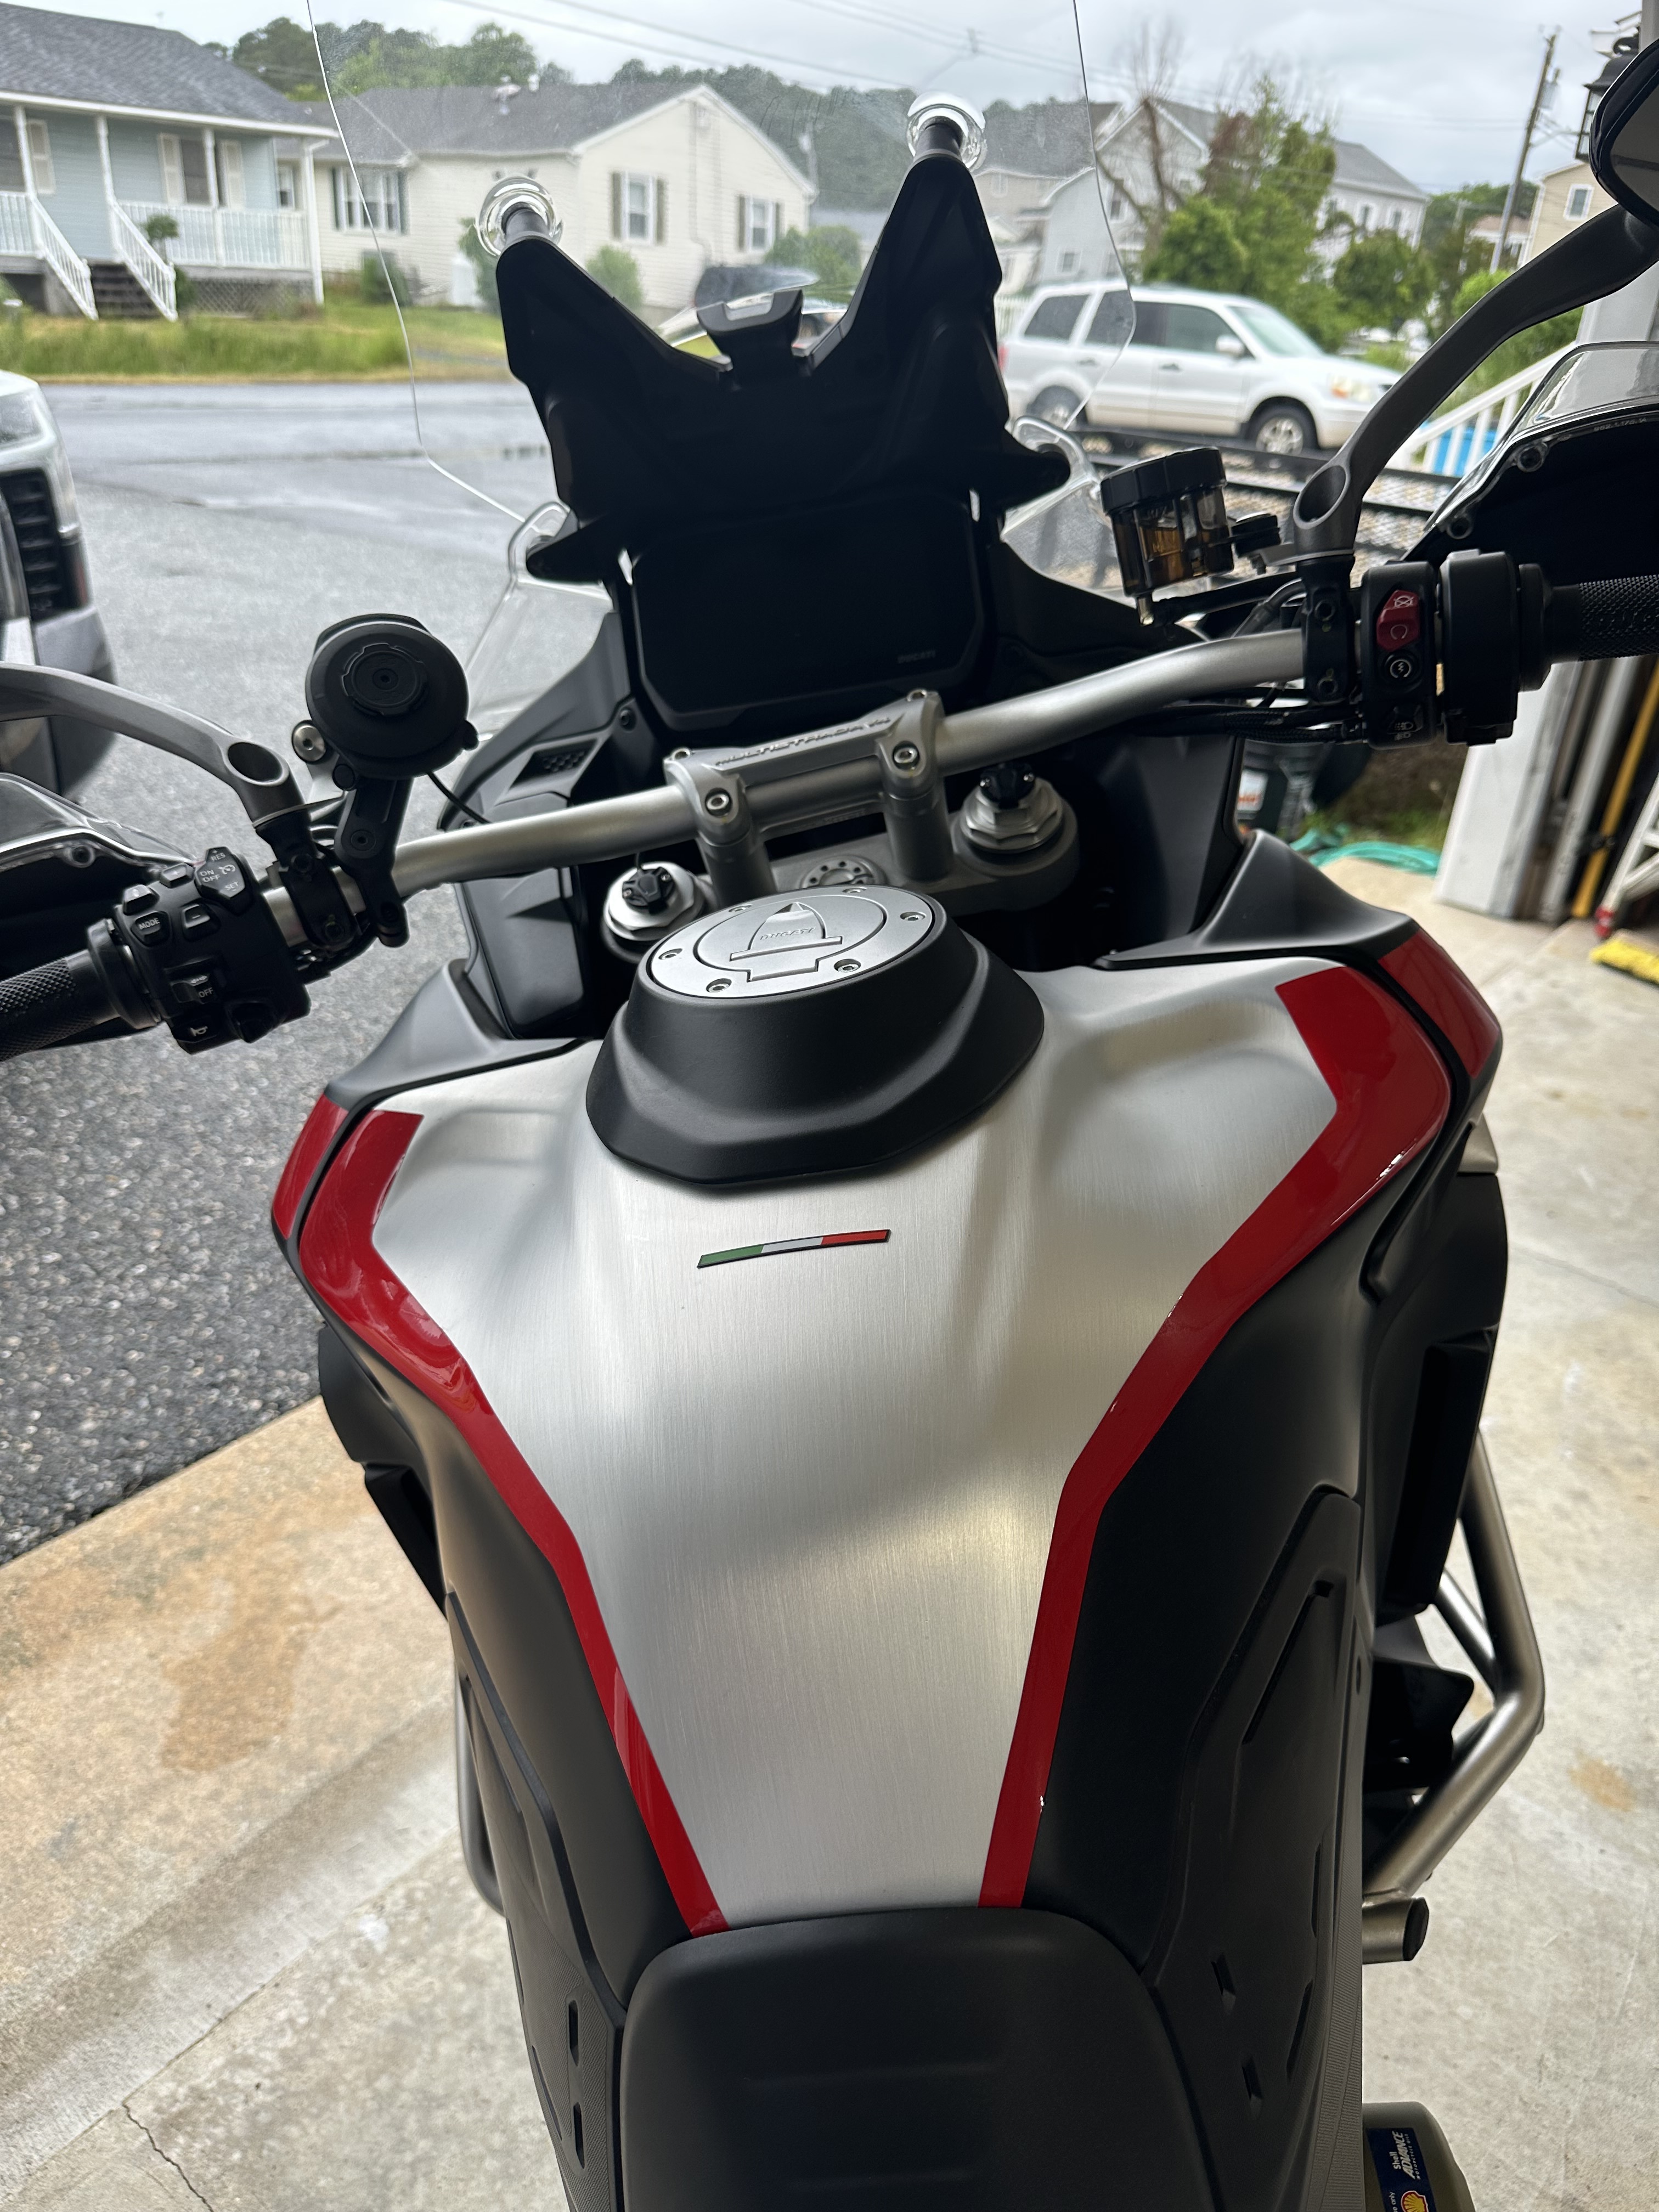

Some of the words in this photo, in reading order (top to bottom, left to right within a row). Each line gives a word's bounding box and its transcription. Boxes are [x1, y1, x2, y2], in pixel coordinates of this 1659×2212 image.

[211, 853, 226, 861] RES
[202, 874, 221, 883] OFF
[224, 881, 239, 890] SET
[139, 918, 160, 929] MODE
[759, 927, 816, 940] DUCATI
[198, 988, 213, 997] OFF
[1391, 2130, 1416, 2180] ADVANCE
[1389, 2152, 1401, 2169] Shell
